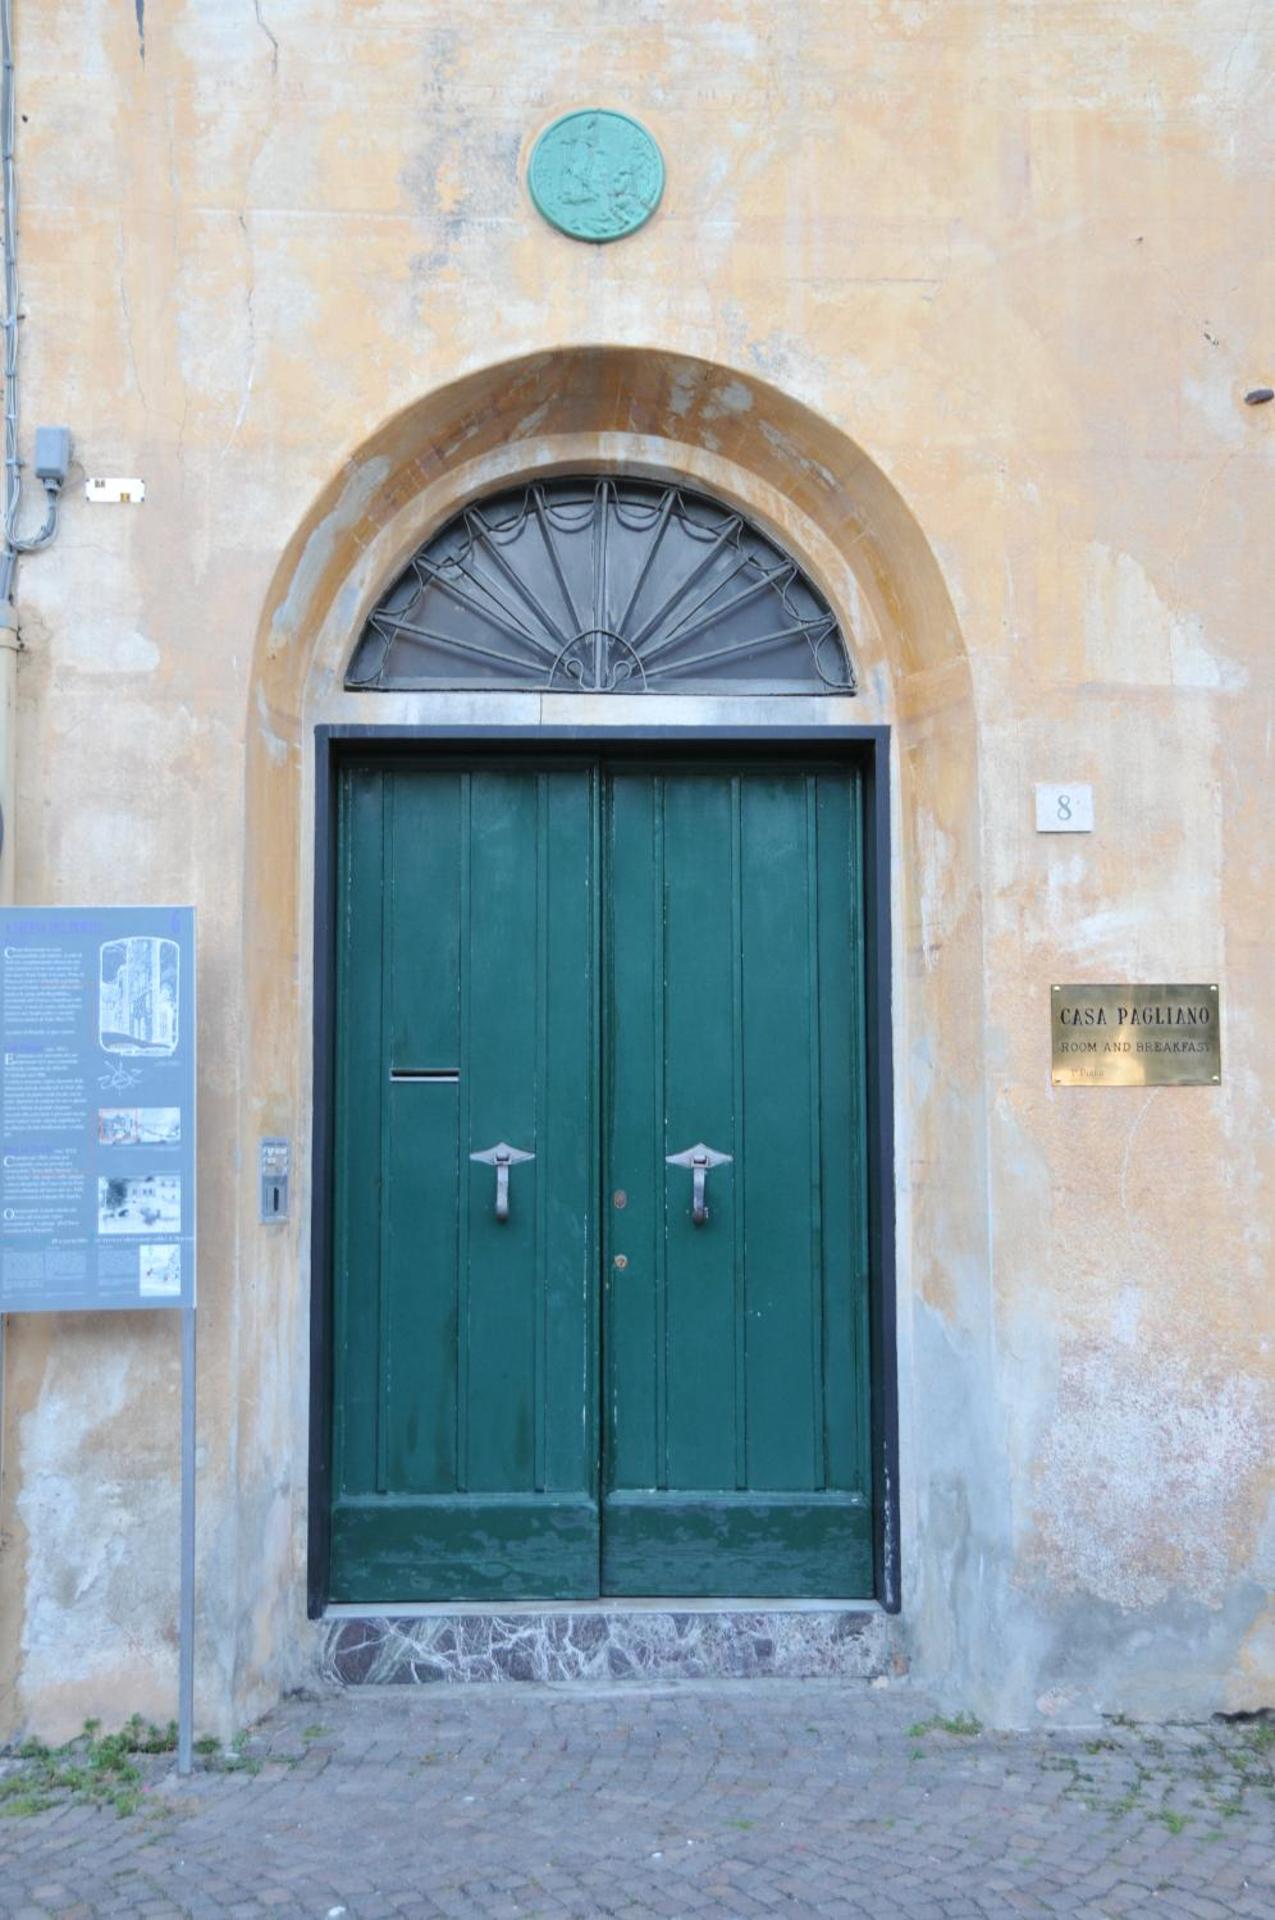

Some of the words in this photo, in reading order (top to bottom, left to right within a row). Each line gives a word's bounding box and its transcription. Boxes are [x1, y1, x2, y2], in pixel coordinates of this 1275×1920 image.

[1057, 794, 1072, 821] 8
[1060, 1007, 1107, 1025] CASA
[1118, 1006, 1210, 1025] PAGLIANO
[1061, 1042, 1097, 1053] ROOM
[1104, 1042, 1131, 1053] AND
[1136, 1042, 1211, 1053] BREAKFAST
